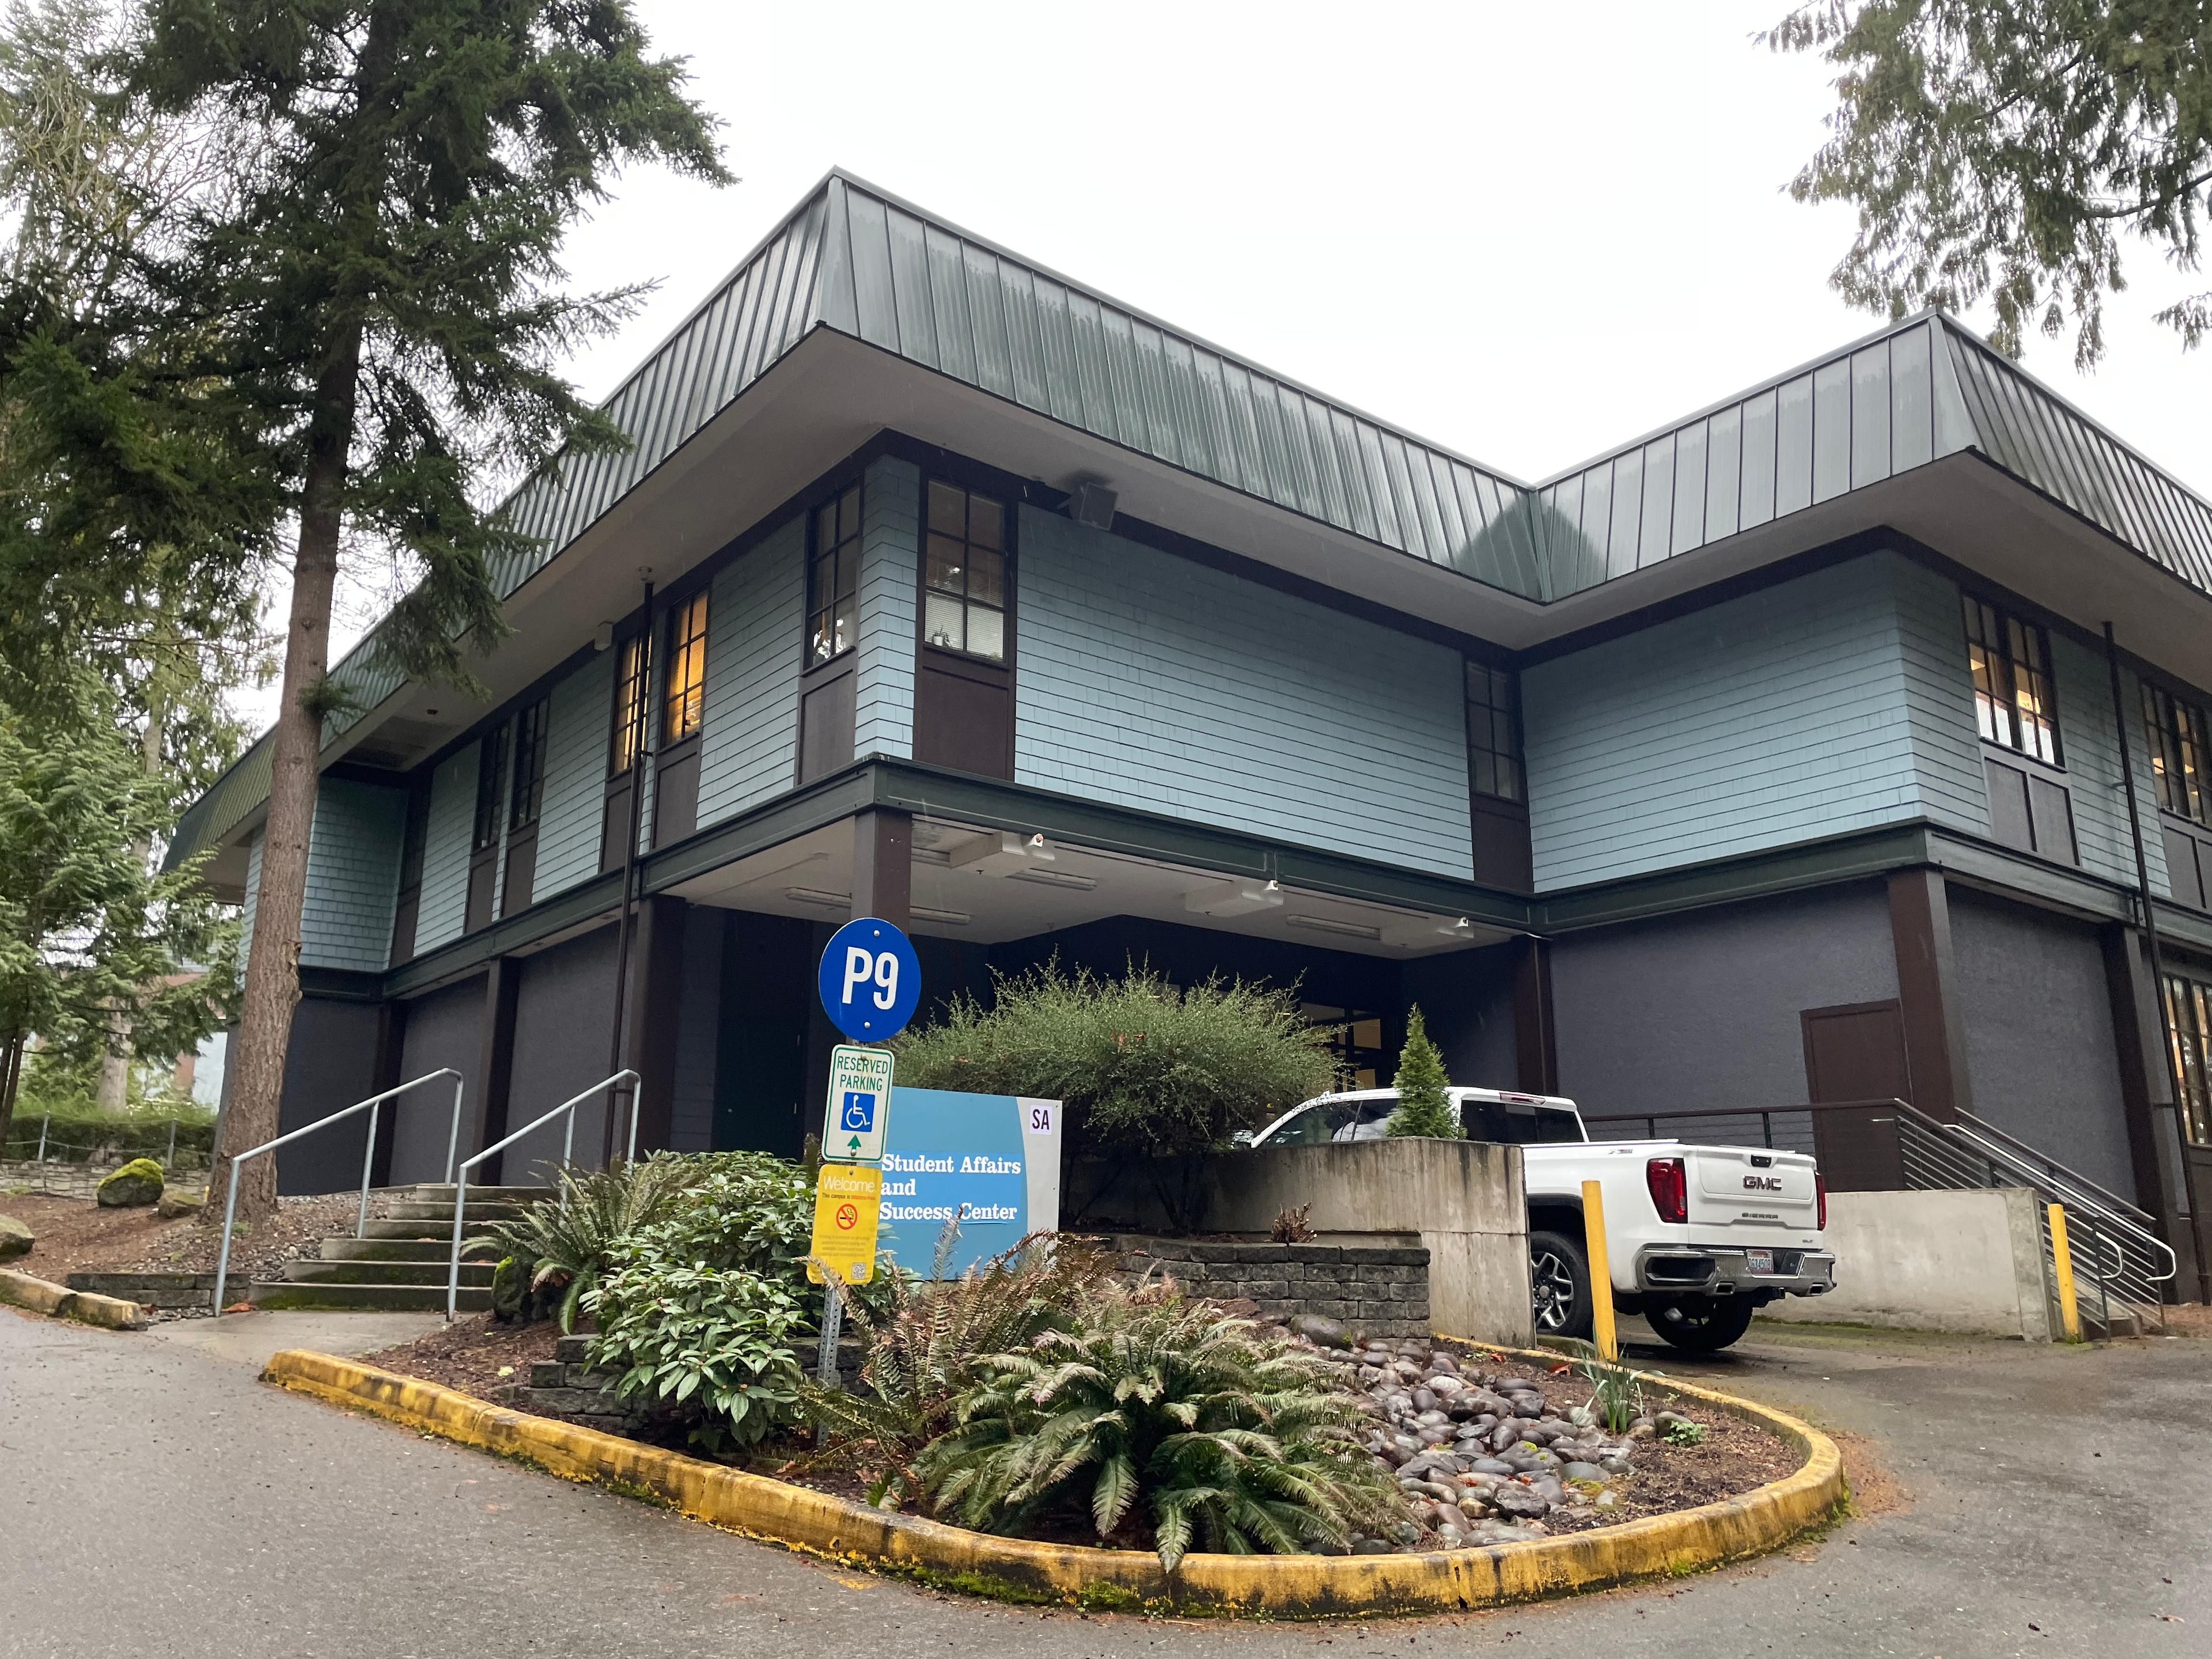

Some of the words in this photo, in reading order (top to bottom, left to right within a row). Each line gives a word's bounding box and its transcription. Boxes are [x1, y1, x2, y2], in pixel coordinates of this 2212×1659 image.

[842, 946, 899, 1010] P9
[837, 1055, 888, 1074] RESERVED
[840, 1074, 882, 1091] PARKING
[1032, 1108, 1050, 1130] SA
[881, 1154, 955, 1173] Student
[959, 1156, 1021, 1175] Affairs
[881, 1179, 916, 1196] and
[1743, 1175, 1782, 1191] GMC
[879, 1202, 953, 1221] Success
[960, 1202, 1017, 1220] Center
